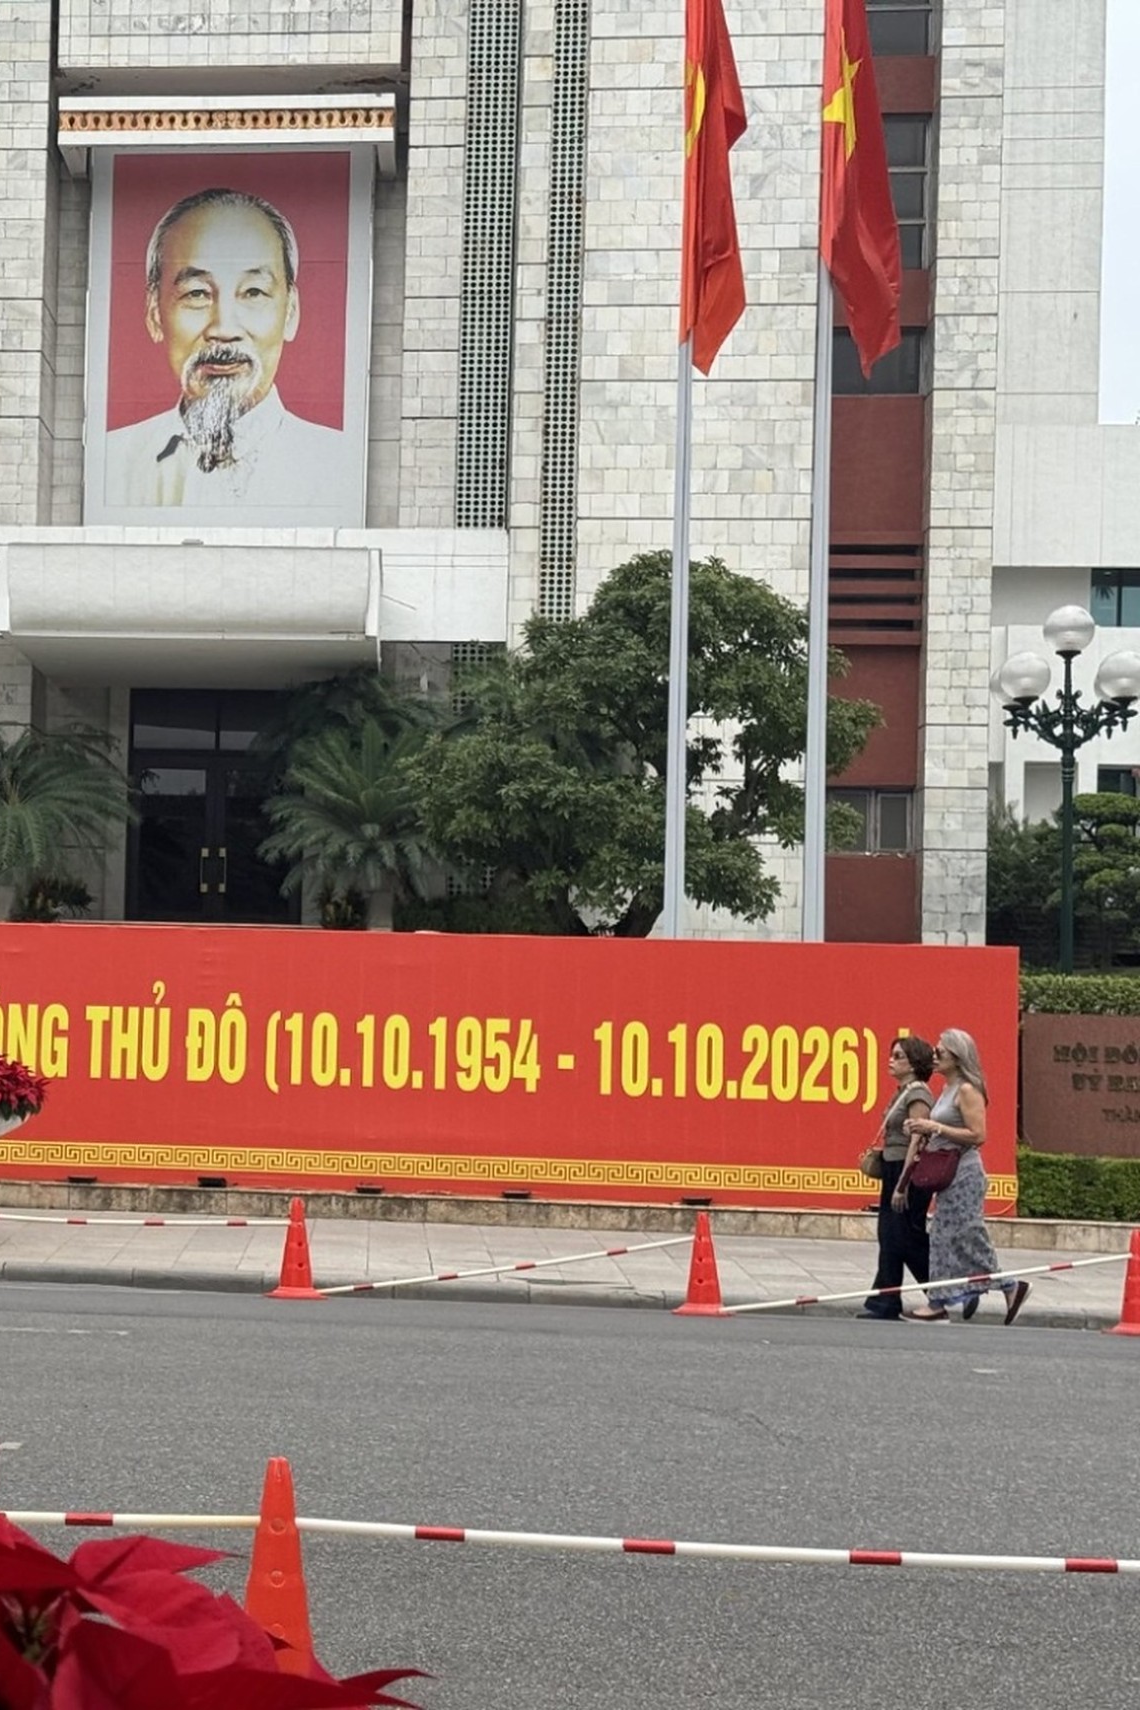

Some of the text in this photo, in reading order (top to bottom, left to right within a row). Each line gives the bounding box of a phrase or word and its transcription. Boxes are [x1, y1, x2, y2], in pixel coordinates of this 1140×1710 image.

[85, 980, 171, 1081] THỦ
[185, 992, 248, 1084] ĐÔ
[265, 1011, 541, 1094] (10.10.1954
[557, 1053, 575, 1070] -
[594, 1021, 878, 1113] 10.10.2026)
